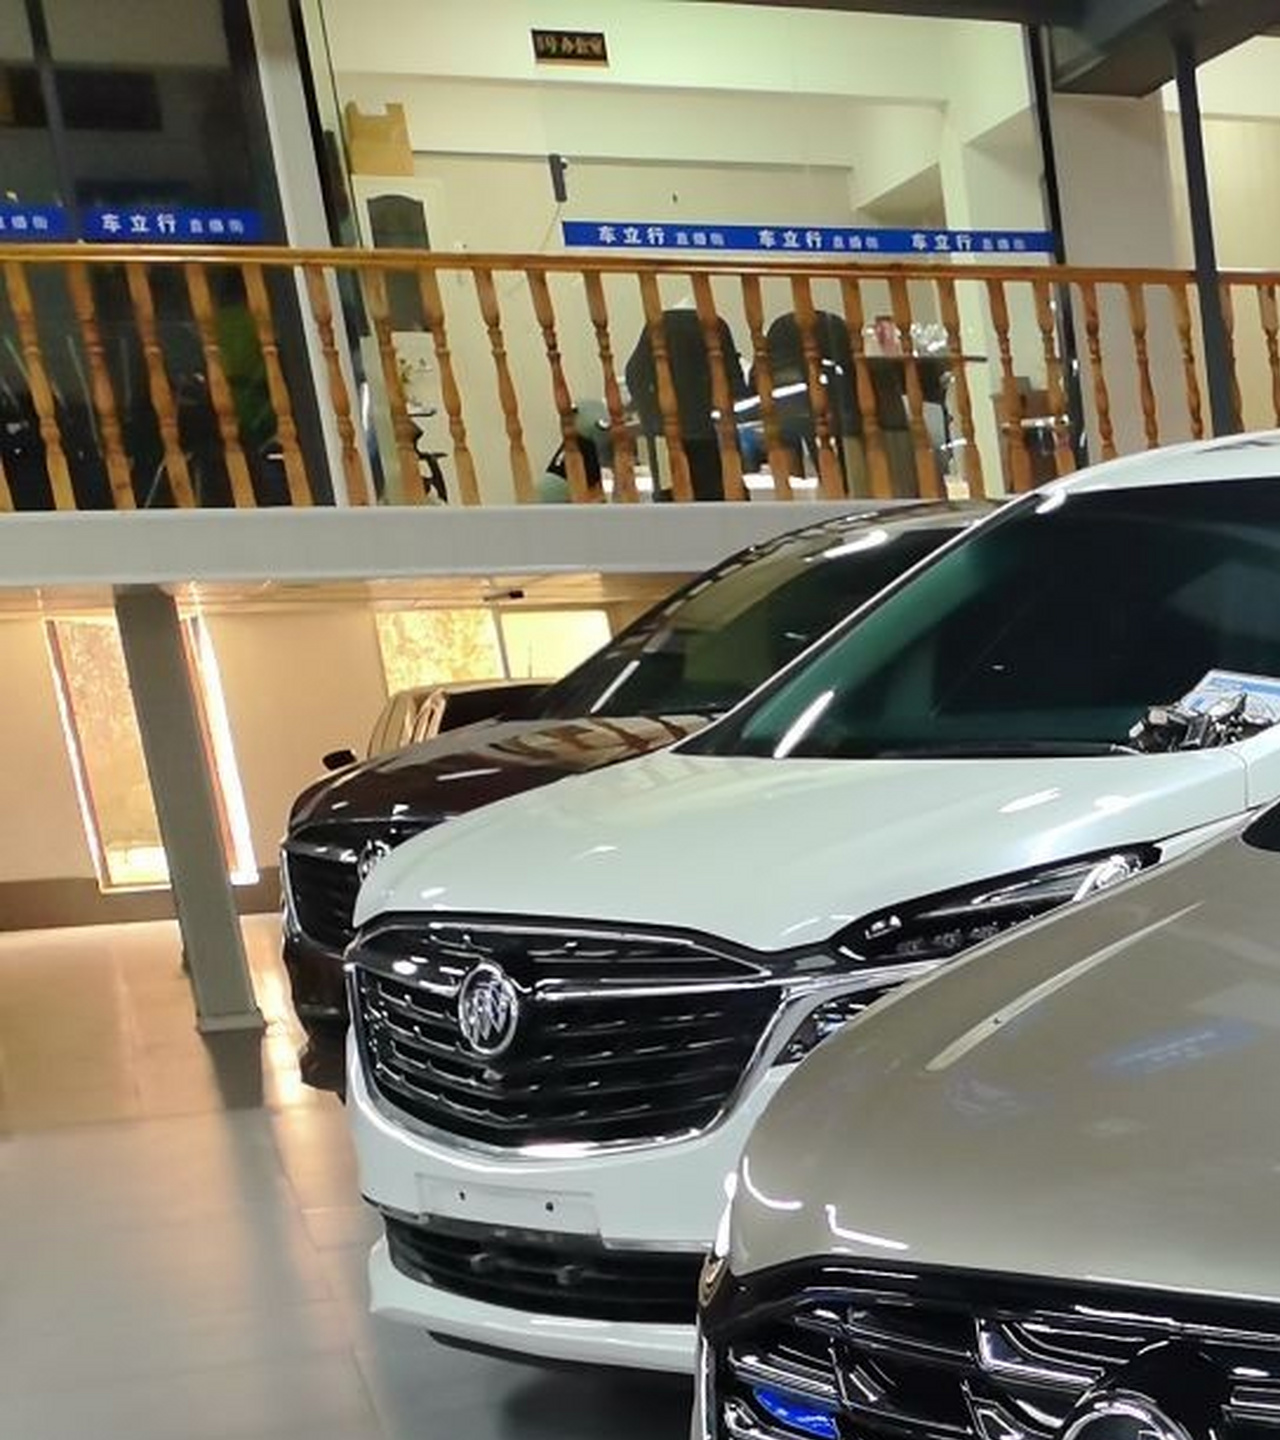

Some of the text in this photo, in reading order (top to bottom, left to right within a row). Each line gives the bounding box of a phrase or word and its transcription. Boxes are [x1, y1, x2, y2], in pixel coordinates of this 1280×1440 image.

[100, 213, 177, 234] 车立行
[598, 225, 665, 246] 车立行
[757, 230, 823, 249] 车立行
[911, 233, 974, 252] 车立行
